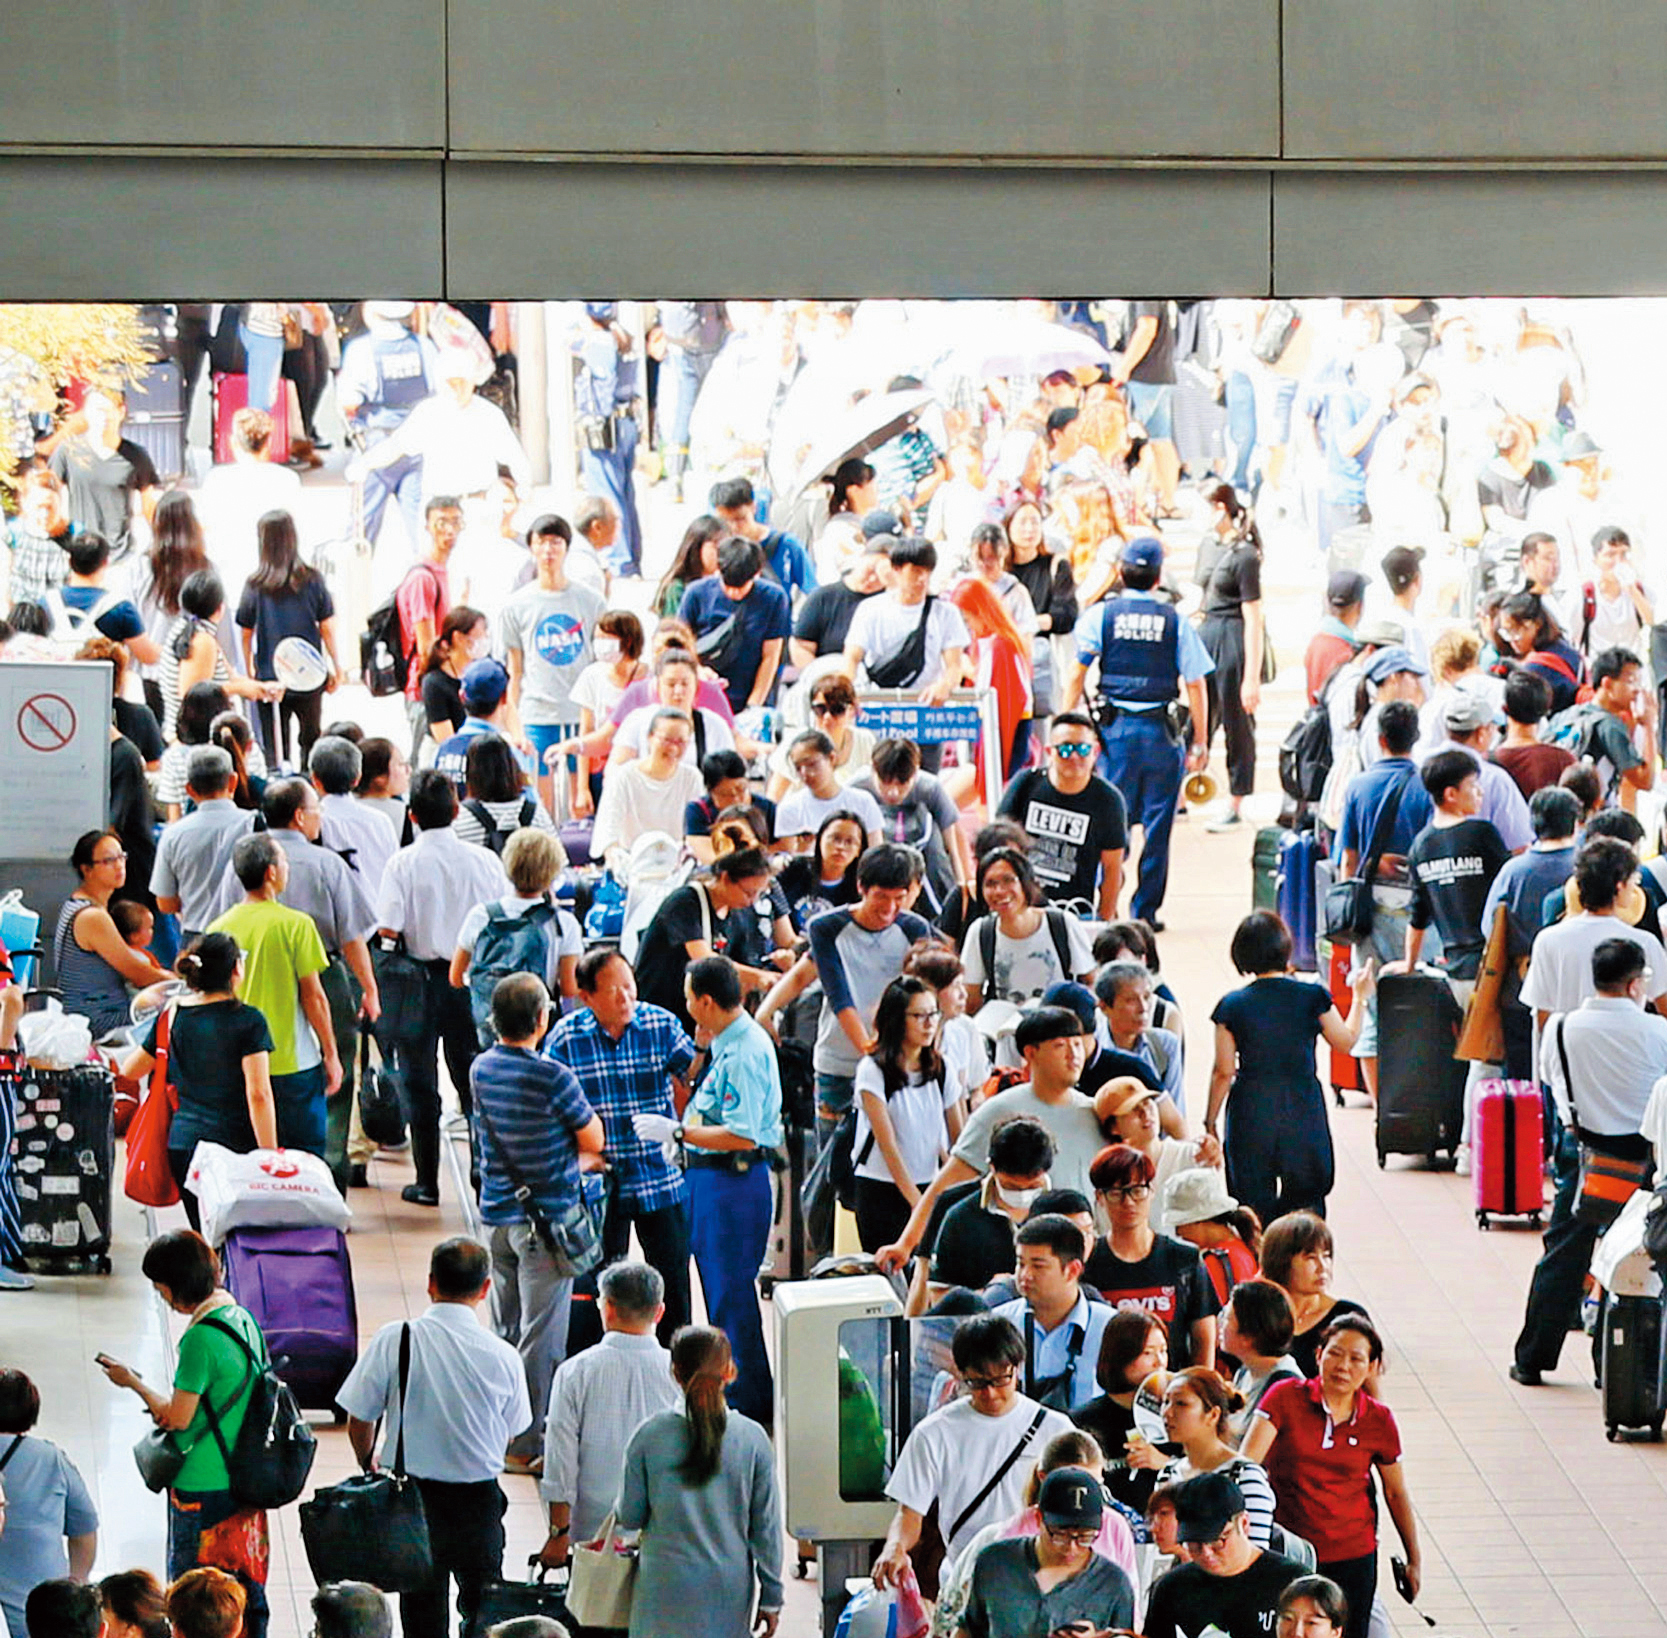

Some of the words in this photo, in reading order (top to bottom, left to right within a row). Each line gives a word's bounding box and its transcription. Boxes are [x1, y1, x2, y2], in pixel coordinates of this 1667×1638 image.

[537, 626, 583, 649] NASA
[1114, 629, 1163, 642] POLICE
[1033, 808, 1082, 838] LEVI'S
